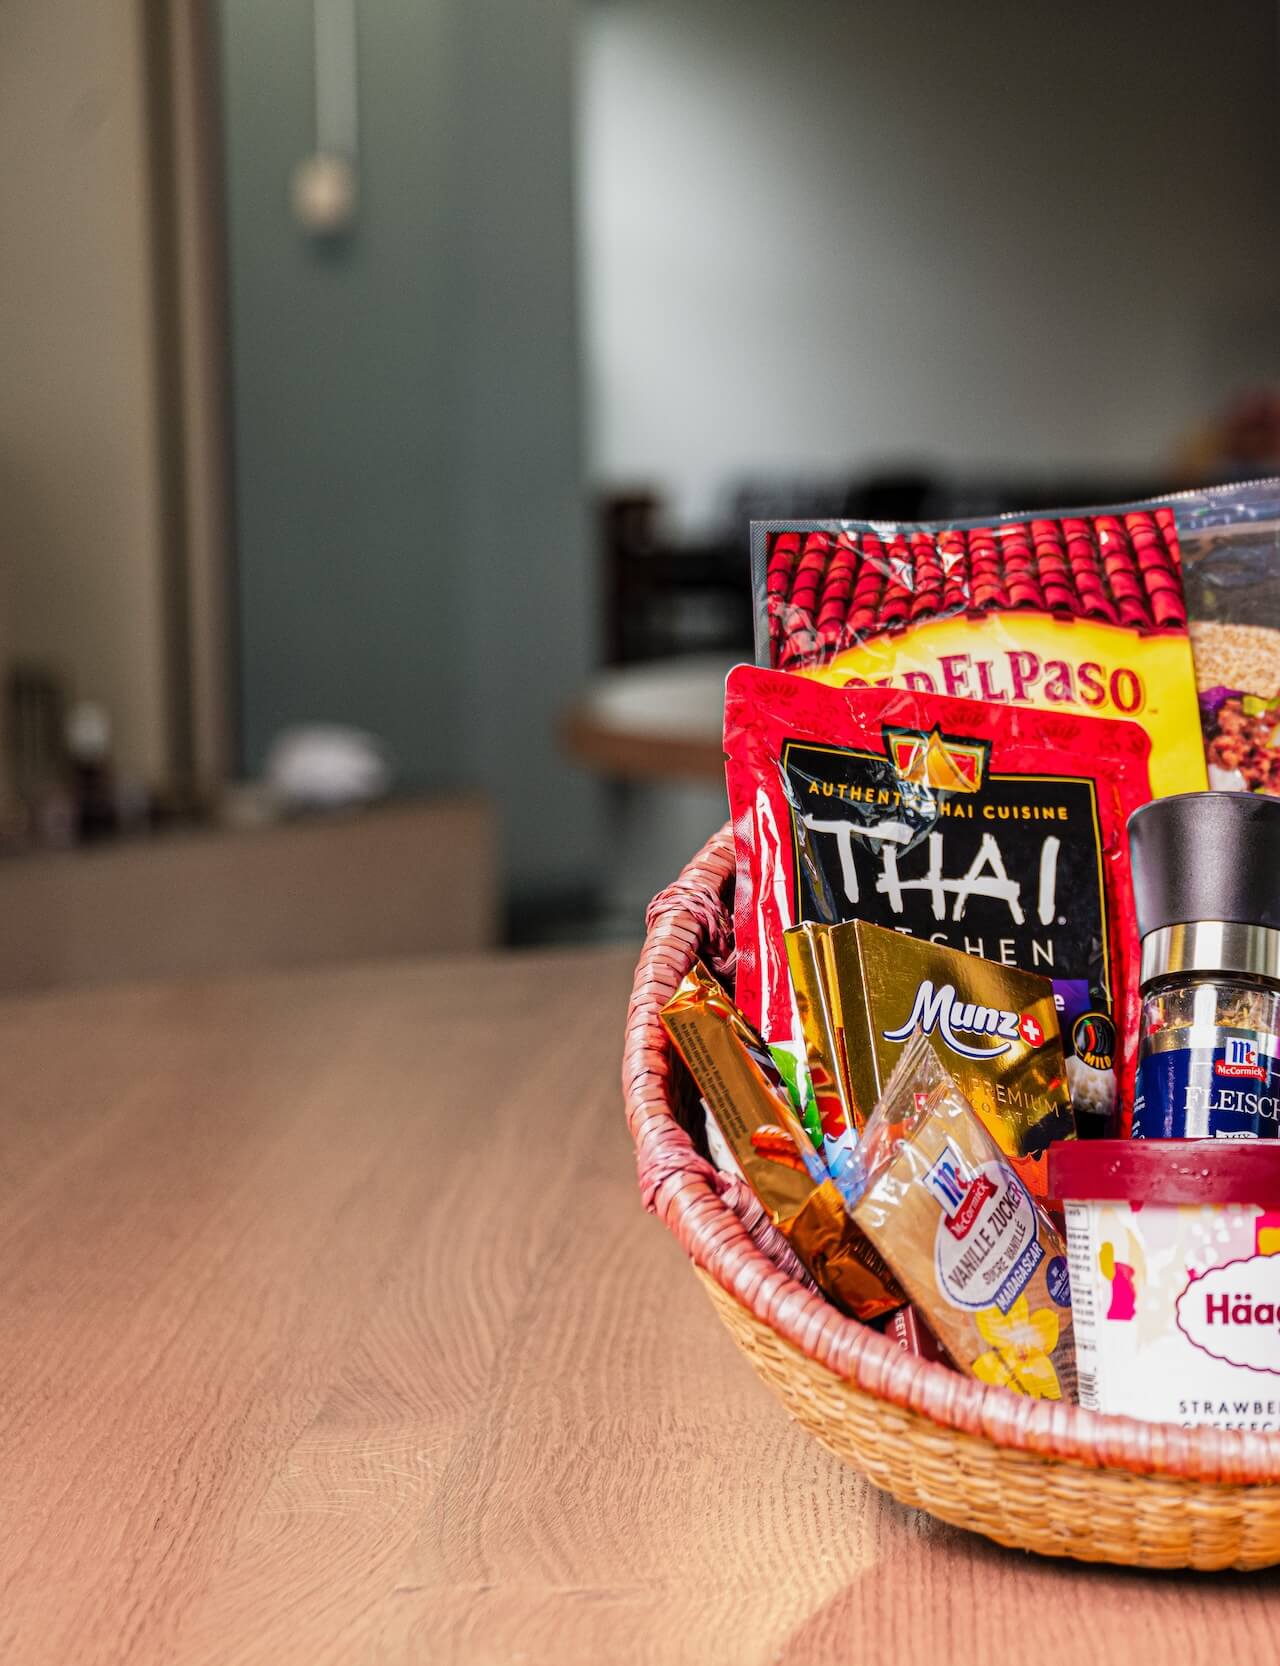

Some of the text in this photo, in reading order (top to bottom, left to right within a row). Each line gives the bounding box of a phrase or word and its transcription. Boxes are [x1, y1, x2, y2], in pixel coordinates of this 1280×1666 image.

[808, 780, 1070, 821] AUTHENT HAI CUISINE
[800, 812, 1060, 926] THAI
[881, 979, 1021, 1061] Munz
[1083, 1051, 1112, 1070] MILD
[1217, 1064, 1264, 1078] McCormick
[948, 1180, 1024, 1291] VANILLE ZUCKER
[950, 1181, 990, 1236] McCormick
[996, 1241, 1043, 1311] MADAGASCAR
